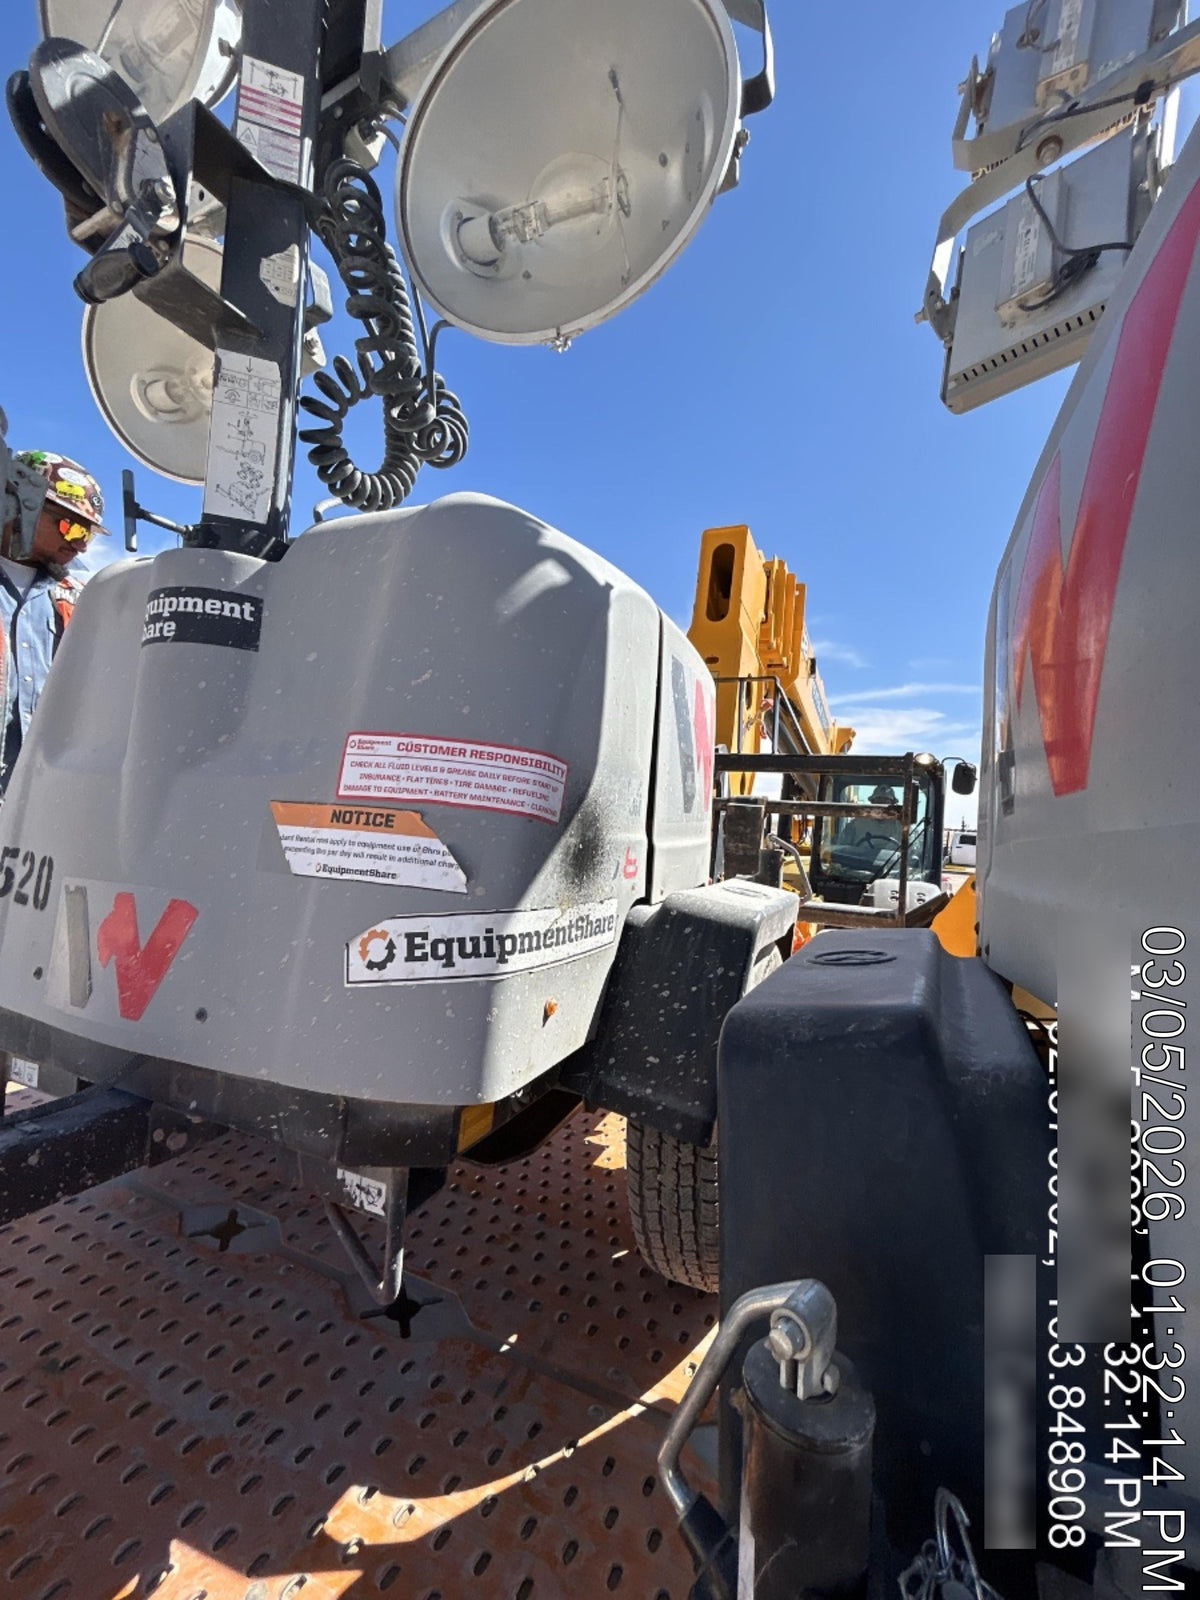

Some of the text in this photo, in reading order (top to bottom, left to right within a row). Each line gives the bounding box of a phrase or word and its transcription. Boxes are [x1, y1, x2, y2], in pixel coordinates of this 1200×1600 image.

[397, 742, 566, 778] CUSTOMER RESPONSIBILITY
[388, 762, 410, 770] FLUID
[412, 764, 438, 773] LEVELS
[446, 767, 476, 777] GREASE
[478, 770, 501, 780] DAILY
[502, 775, 531, 785] BEFORE
[344, 784, 372, 792] DAMAGE
[384, 786, 428, 796] EQUIPMENT
[434, 791, 468, 800] BATTERY
[469, 794, 526, 808] MAINTENANCE
[360, 773, 400, 782] INSURANCE
[426, 777, 448, 786] TIRES
[454, 781, 472, 789] TIRE
[474, 782, 507, 793] DAMAGE
[512, 787, 550, 802] REFUELING
[330, 809, 396, 829] NOTICE
[357, 841, 396, 852] equipment
[366, 852, 388, 862] result
[396, 856, 437, 867] additional
[322, 863, 397, 880] EquipmentShare
[404, 913, 615, 969] EquipmentShare
